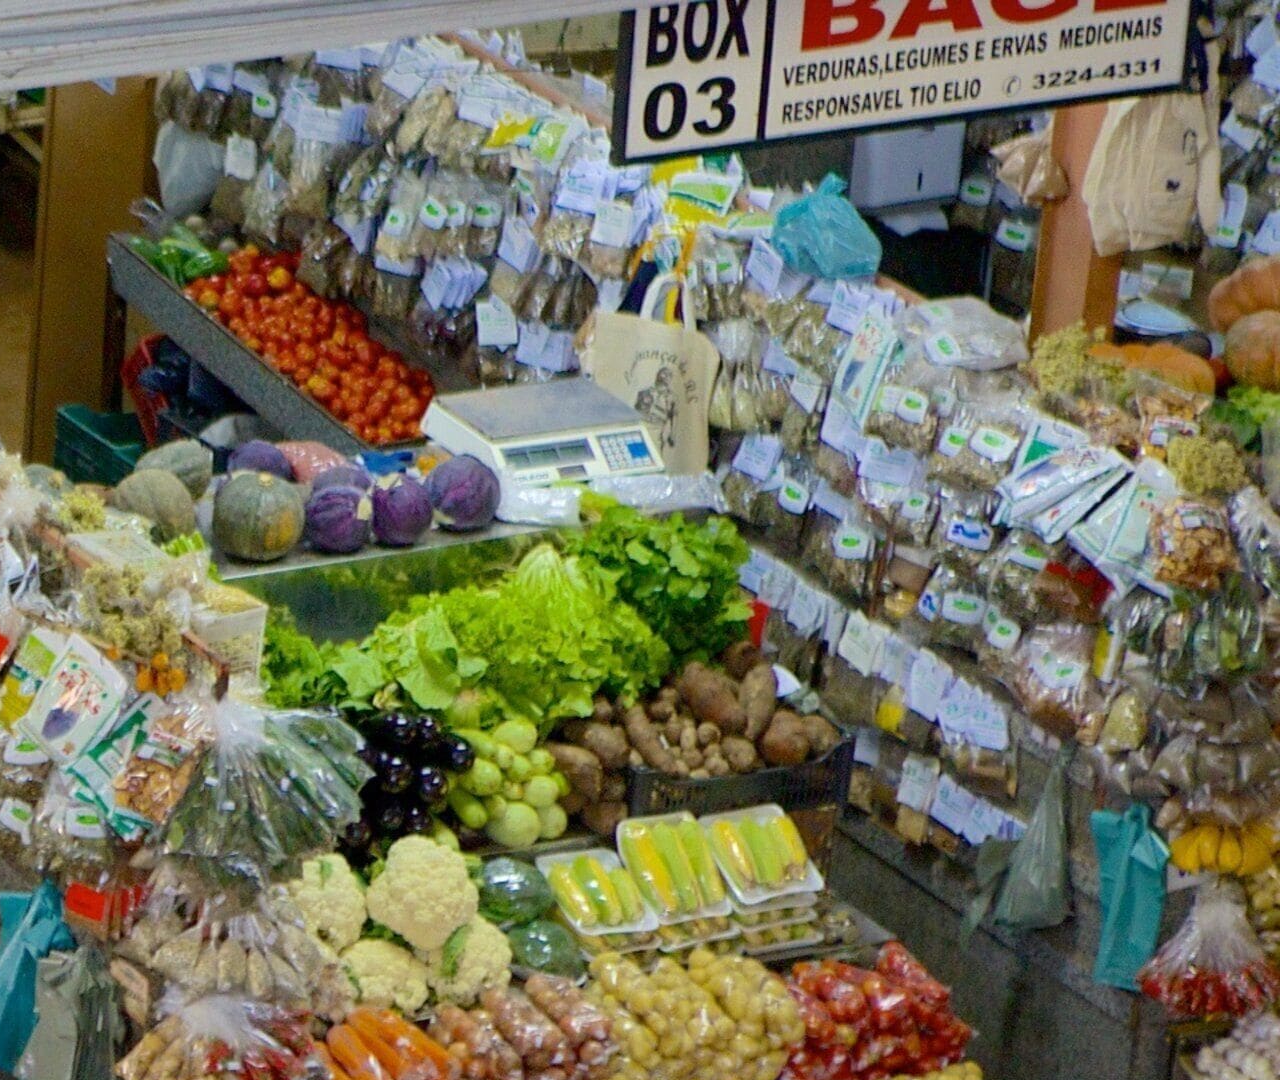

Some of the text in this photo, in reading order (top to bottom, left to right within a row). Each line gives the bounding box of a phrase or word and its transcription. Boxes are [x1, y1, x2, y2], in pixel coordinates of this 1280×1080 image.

[646, 0, 750, 69] BOX
[975, 40, 986, 61] E
[991, 32, 1048, 58] ERVAS
[1059, 16, 1163, 50] MEDICINAIS
[643, 77, 736, 142] 03
[782, 58, 1162, 124] RESPONSAVEL TIO ELIO 3224-4331
